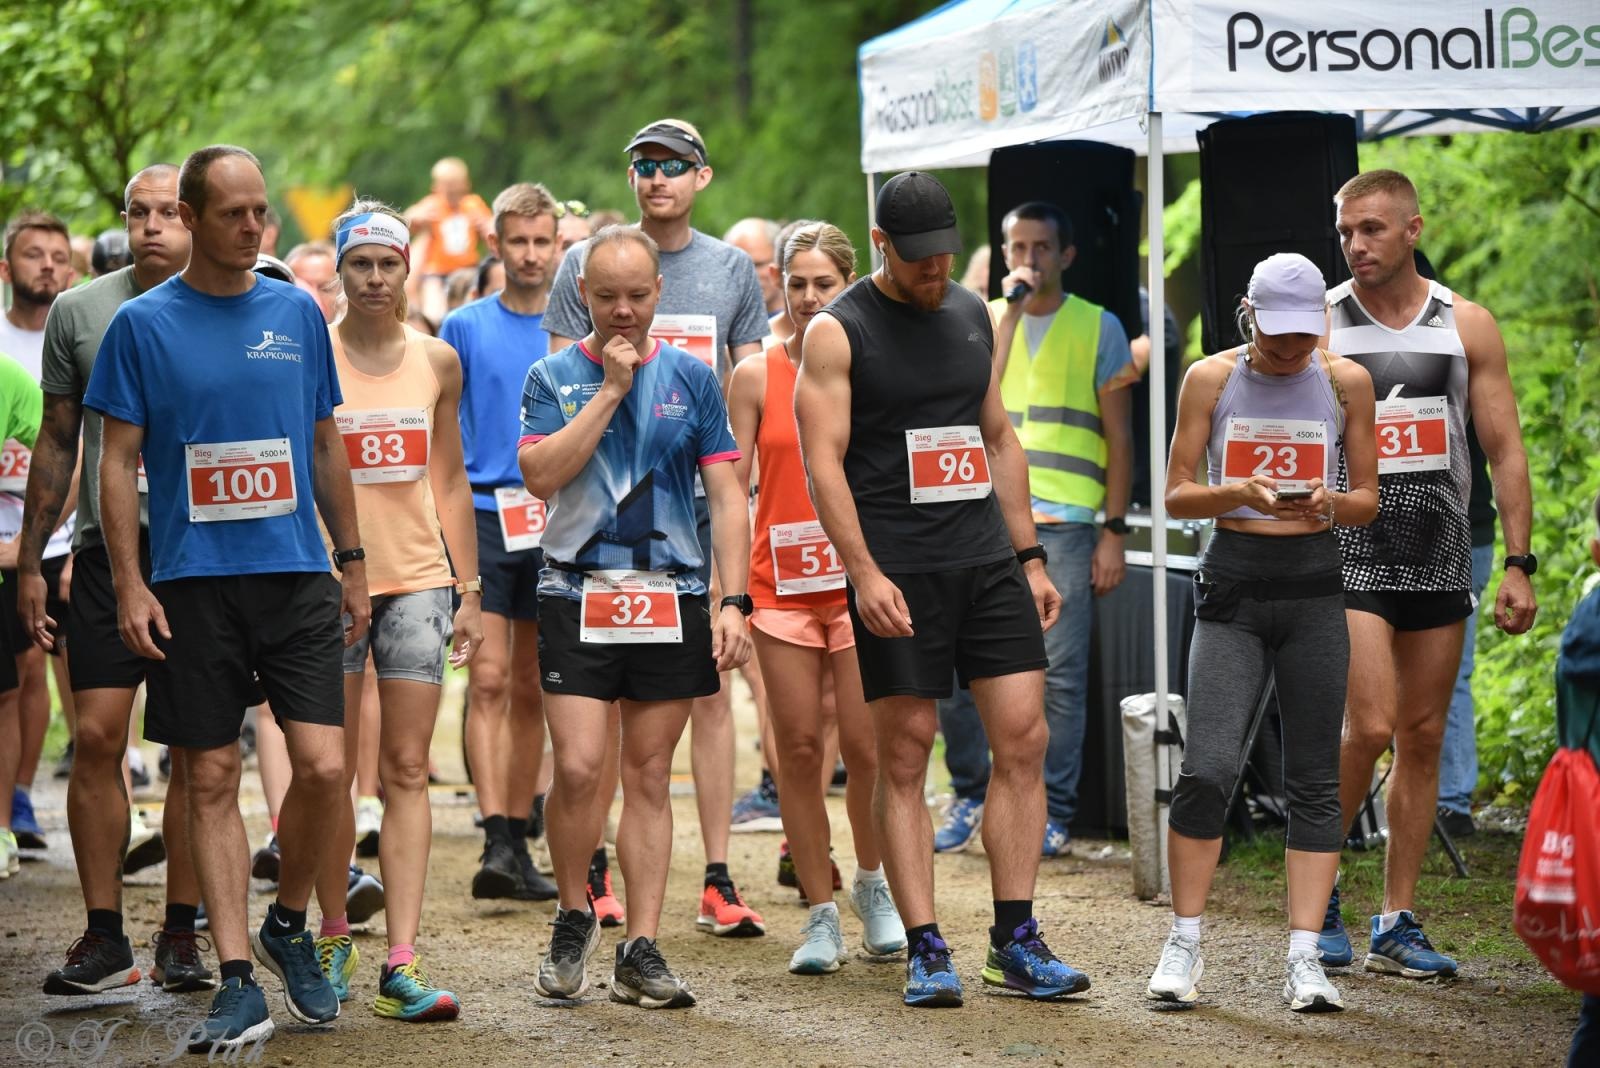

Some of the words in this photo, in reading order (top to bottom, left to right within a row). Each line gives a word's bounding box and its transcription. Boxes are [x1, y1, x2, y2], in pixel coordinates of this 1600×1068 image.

[336, 417, 354, 425] Bieg
[400, 417, 417, 425] 4500
[1418, 407, 1435, 415] 4500
[1233, 423, 1250, 433] Bieg
[1296, 431, 1315, 439] 4500
[1315, 432, 1323, 440] M
[914, 434, 932, 443] Bieg
[1379, 424, 1423, 456] 31
[194, 449, 212, 459] Bieg
[259, 449, 279, 459] 4500
[361, 433, 406, 465] 83
[938, 450, 975, 483] 96
[1251, 445, 1298, 477] 23
[208, 466, 277, 502] 100
[801, 543, 843, 576] 51
[647, 580, 664, 588] 4500
[610, 594, 654, 625] 32
